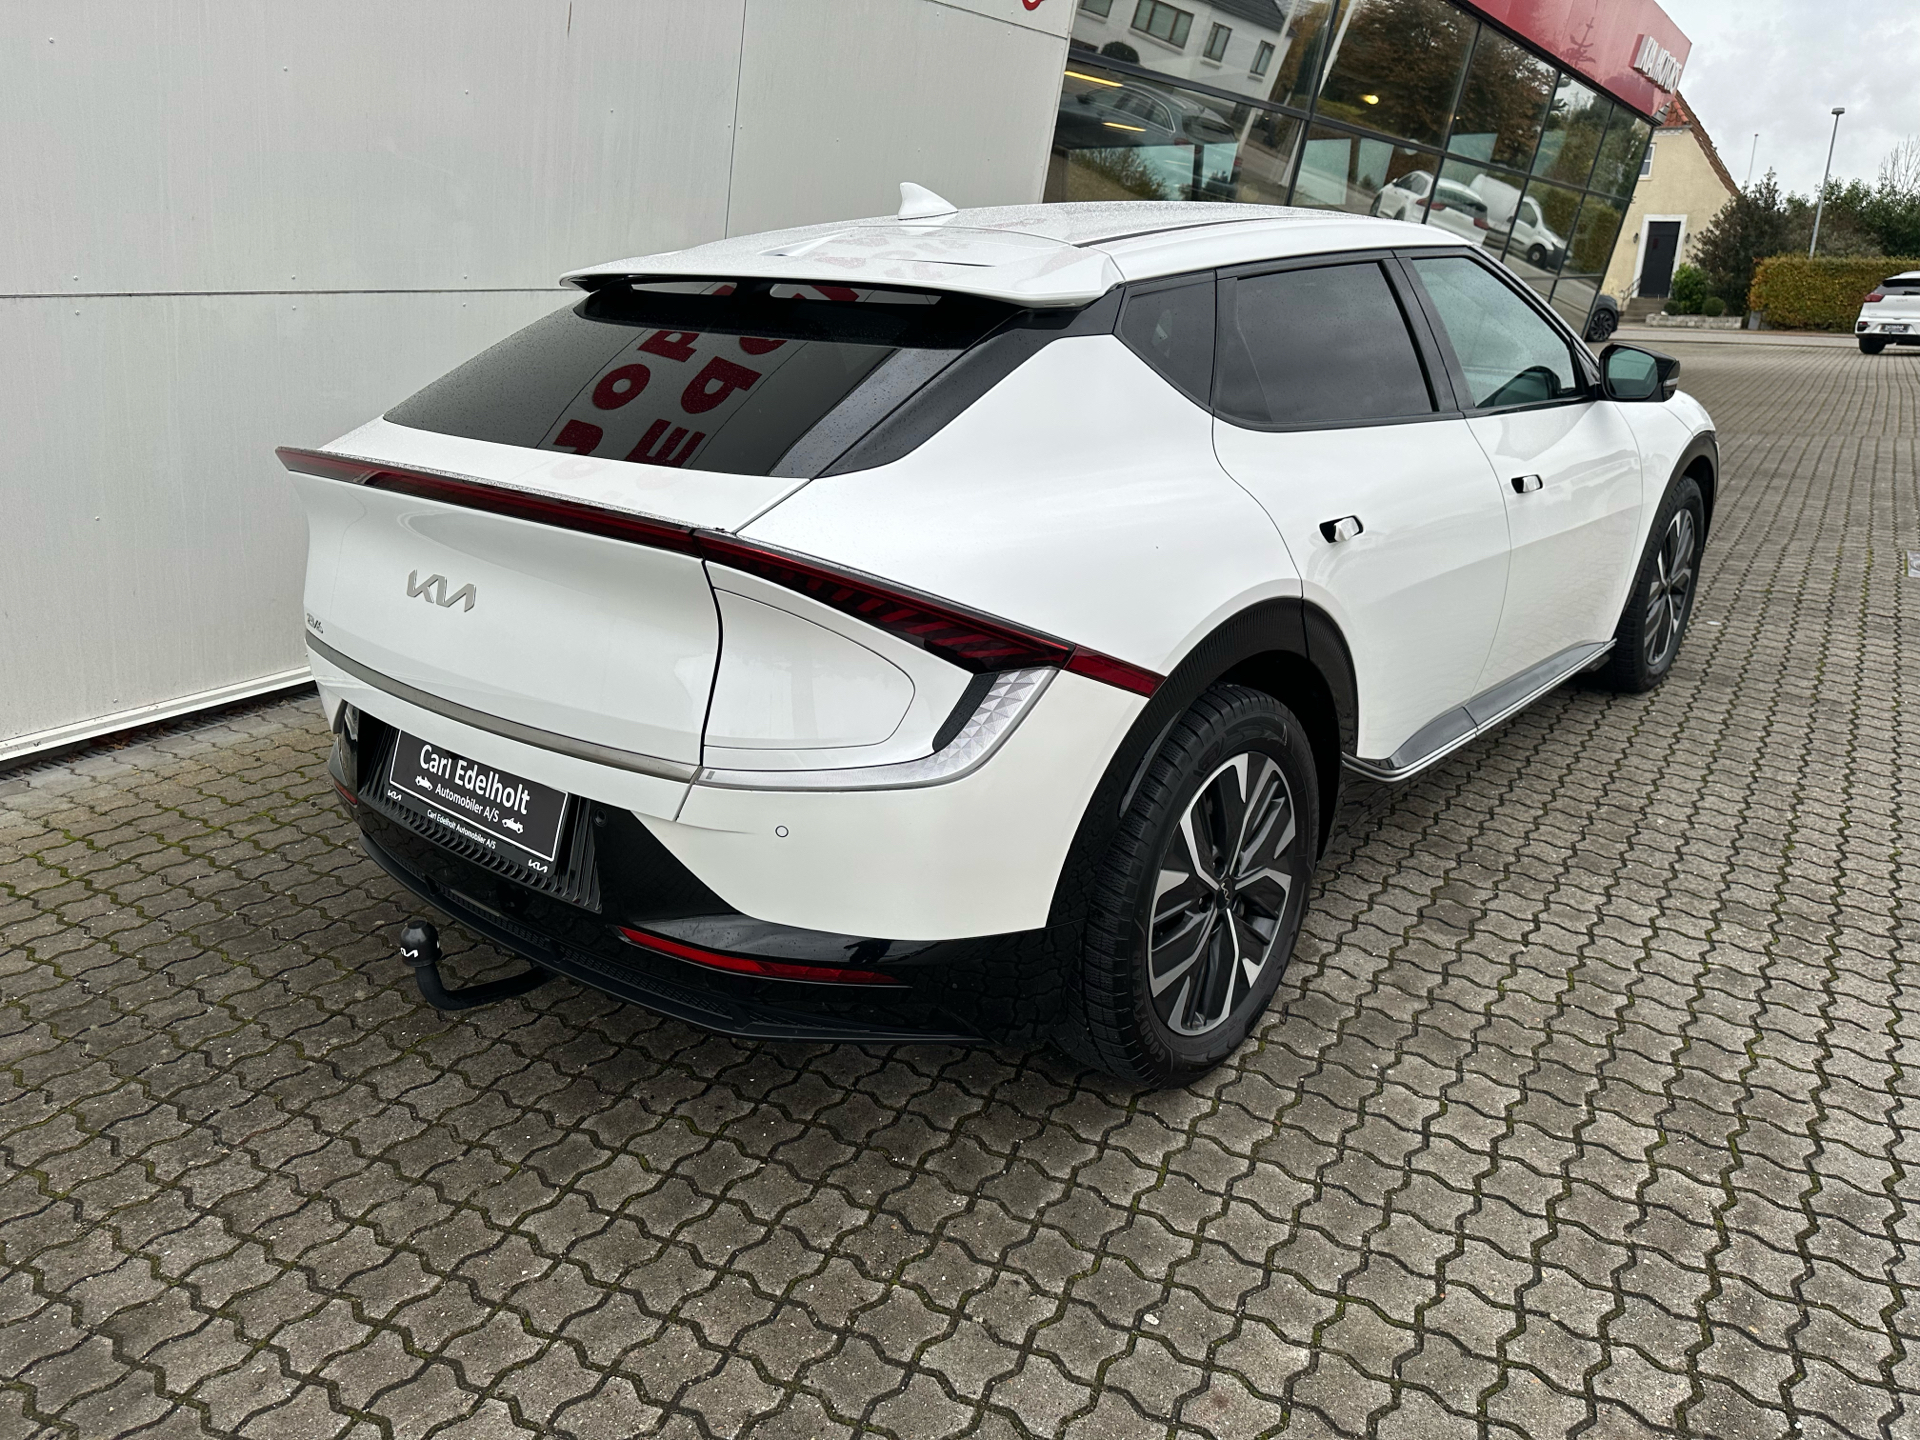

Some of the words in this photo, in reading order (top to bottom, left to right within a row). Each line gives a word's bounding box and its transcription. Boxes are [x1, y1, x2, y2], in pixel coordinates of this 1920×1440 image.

[406, 569, 477, 613] KIA
[387, 790, 402, 802] KIA
[419, 744, 453, 780] Carl
[454, 759, 531, 815] Edelholt
[435, 783, 484, 815] Automobiler
[483, 806, 500, 823] A/S
[427, 809, 437, 821] Carl
[437, 813, 456, 830] Edelholt
[456, 824, 487, 844] Automobiler
[486, 838, 497, 850] A/S
[528, 858, 548, 873] KIA
